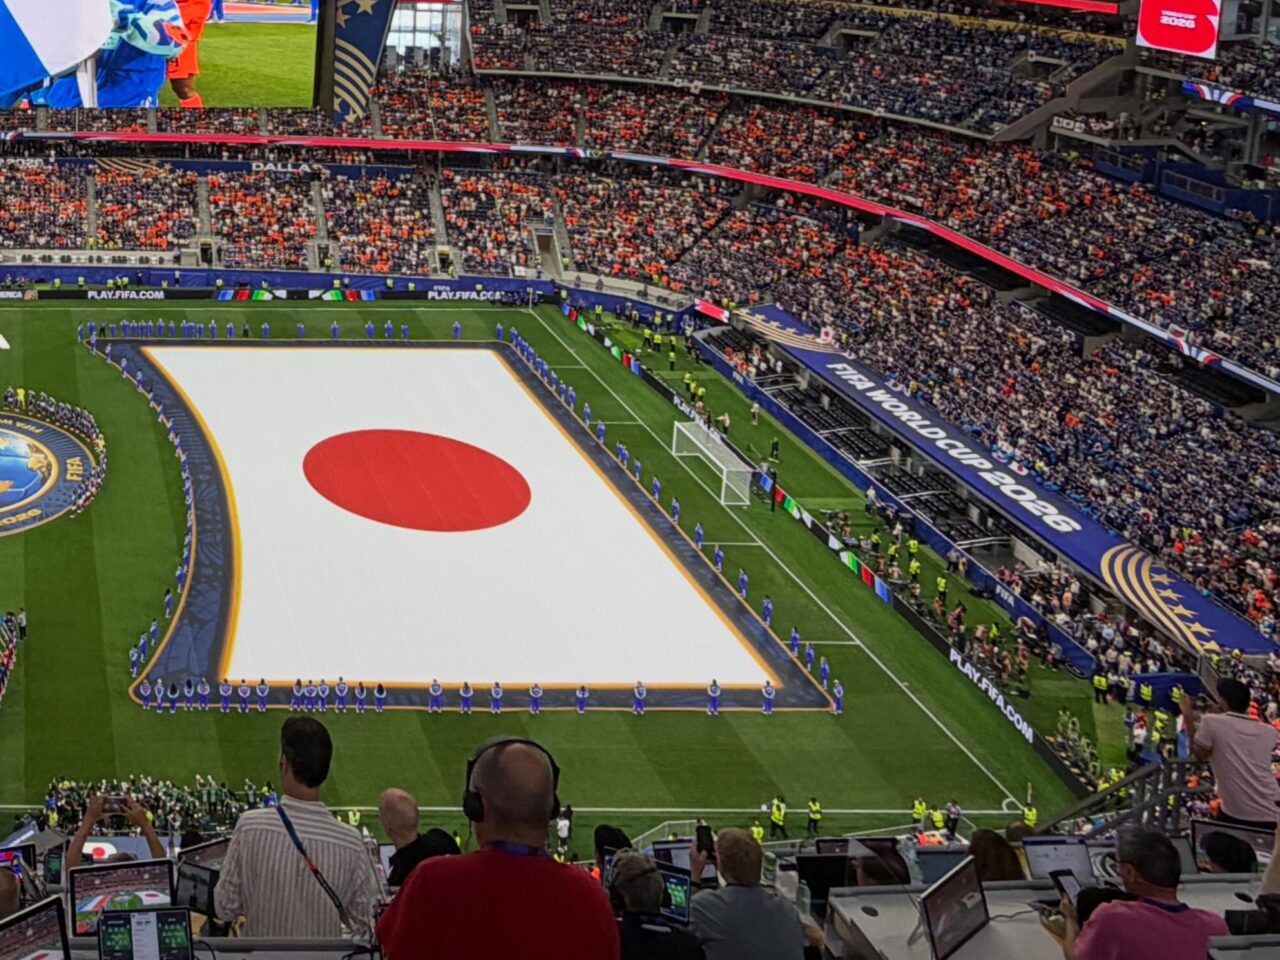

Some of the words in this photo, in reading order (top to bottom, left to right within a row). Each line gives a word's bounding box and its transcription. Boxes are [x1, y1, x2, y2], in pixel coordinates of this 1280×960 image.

[87, 290, 164, 300] PLAY.FIFA.COM
[826, 362, 875, 391] FIFA
[866, 389, 946, 440] WORLD
[935, 439, 993, 471] CUP
[978, 470, 1082, 533] 2026
[65, 456, 84, 482] FIFA
[995, 585, 1015, 607] FIFA
[950, 648, 1033, 743] PLAY.FIFA.COM
